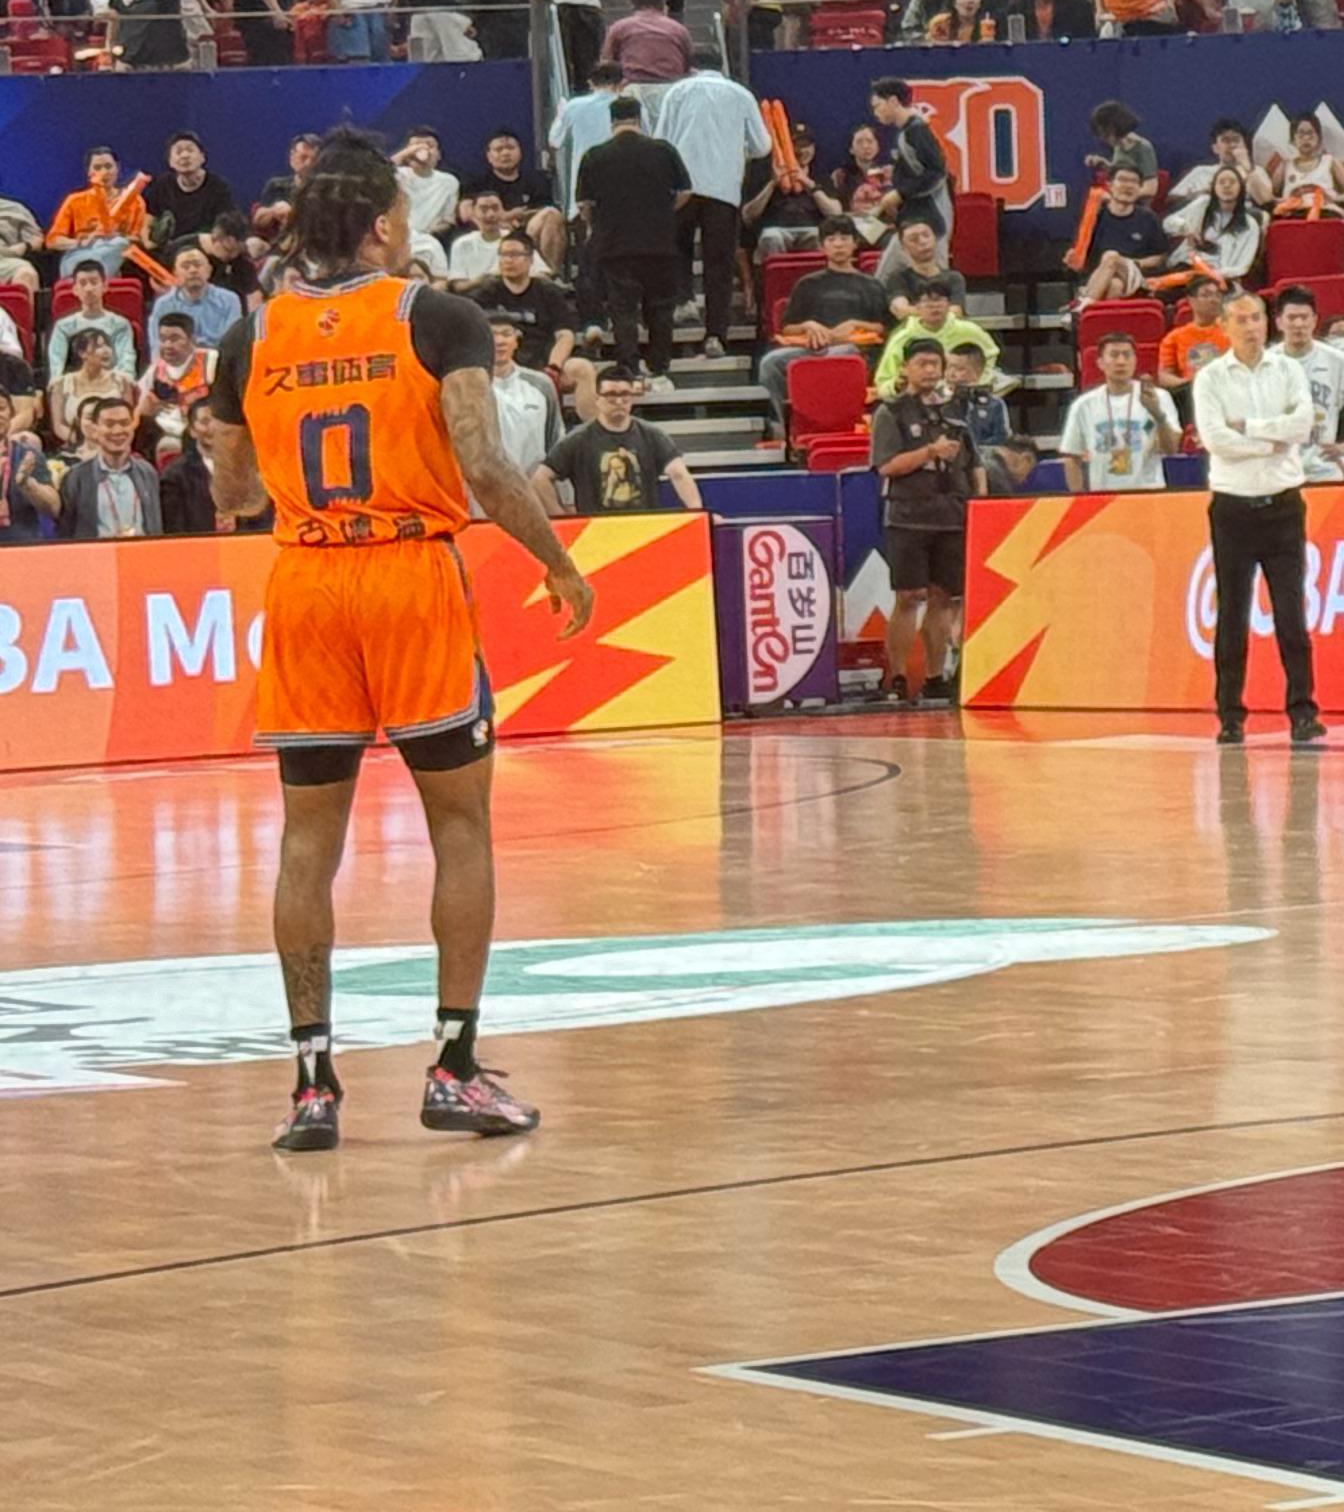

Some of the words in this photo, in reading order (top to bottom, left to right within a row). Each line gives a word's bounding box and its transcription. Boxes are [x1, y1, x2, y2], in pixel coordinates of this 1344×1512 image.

[300, 402, 374, 511] 0
[787, 551, 816, 656] 百岁山
